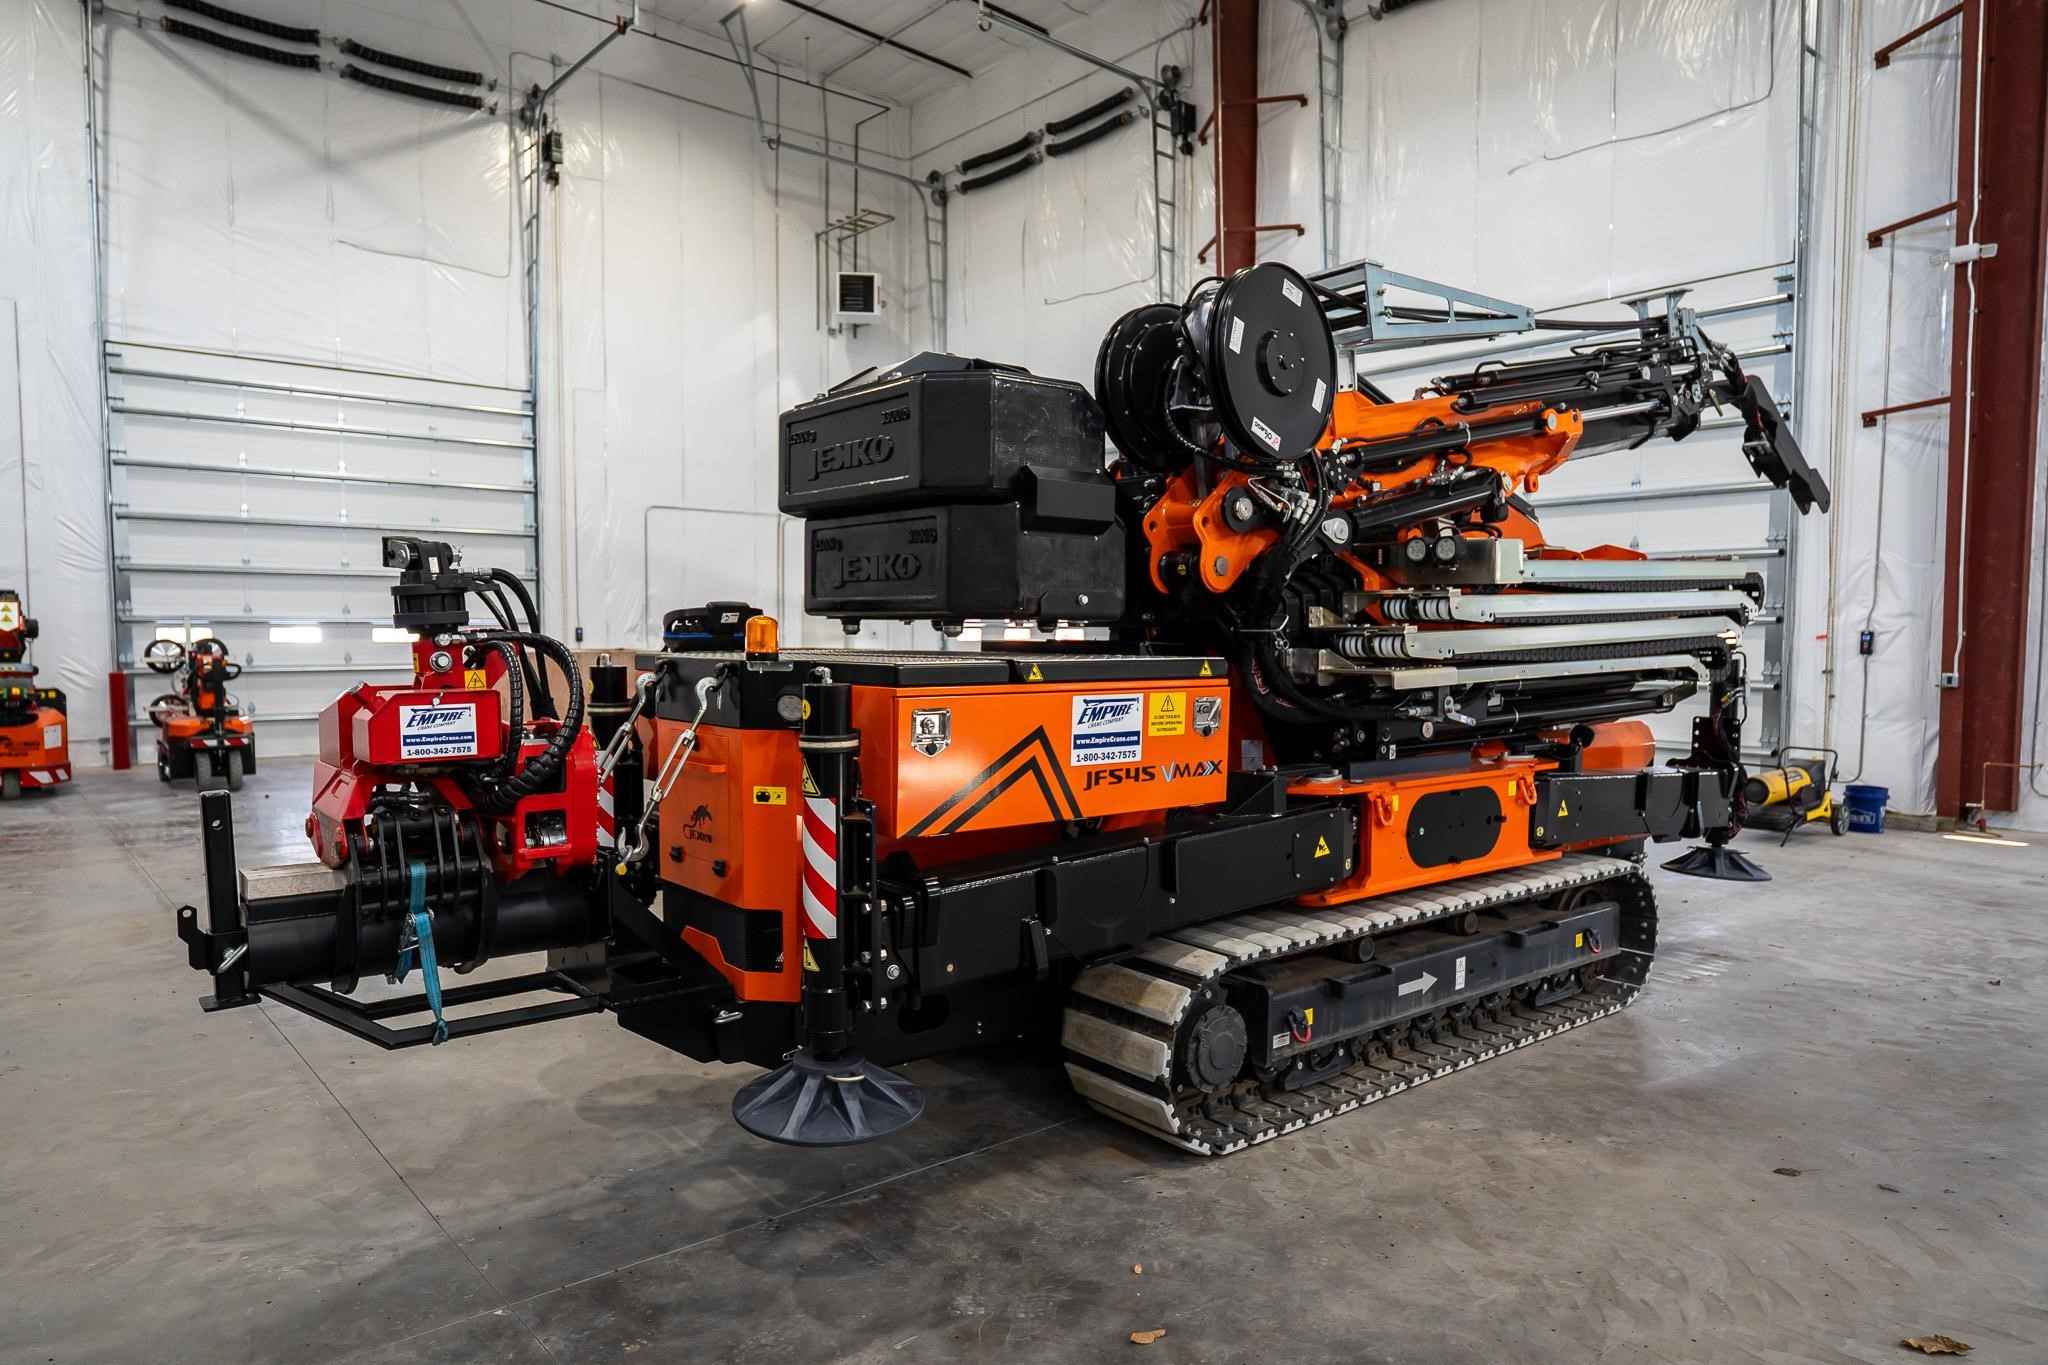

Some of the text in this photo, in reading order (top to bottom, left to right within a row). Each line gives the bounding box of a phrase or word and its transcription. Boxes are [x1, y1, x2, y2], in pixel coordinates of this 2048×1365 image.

[405, 710, 466, 729] EMPIRE
[1077, 703, 1135, 726] EMPIRE
[405, 734, 473, 744] www.EmpireCrane.com
[1076, 735, 1139, 746] www.EmpireCrane.com
[406, 745, 473, 757] 1-800-342-7575
[1076, 750, 1137, 763] 1-800-342-7575
